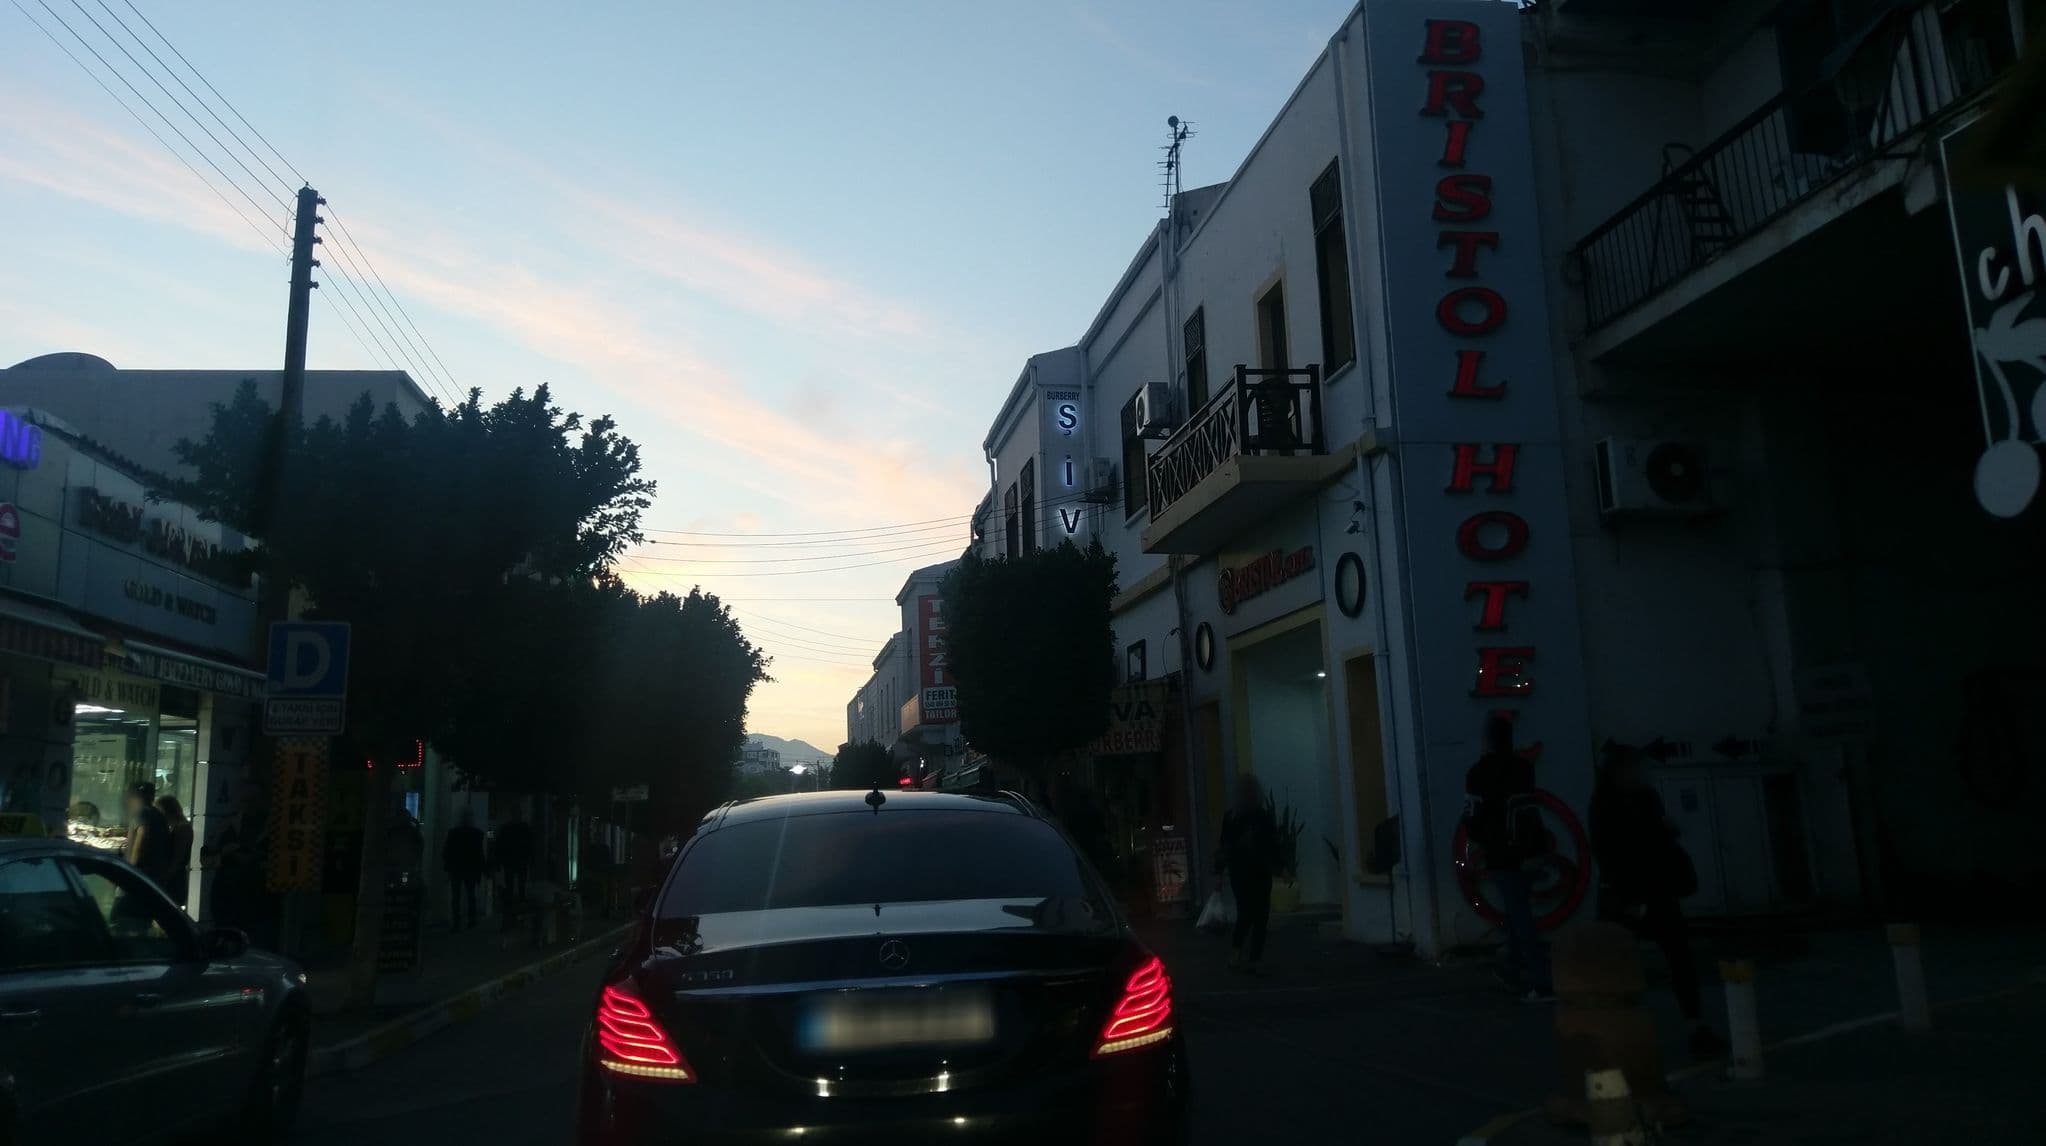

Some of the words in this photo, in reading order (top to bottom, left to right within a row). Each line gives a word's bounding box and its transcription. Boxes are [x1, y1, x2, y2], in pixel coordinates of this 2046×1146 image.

[1417, 18, 1508, 400] BRISTOL
[1047, 391, 1081, 401] BURBERRY
[286, 631, 331, 689] D
